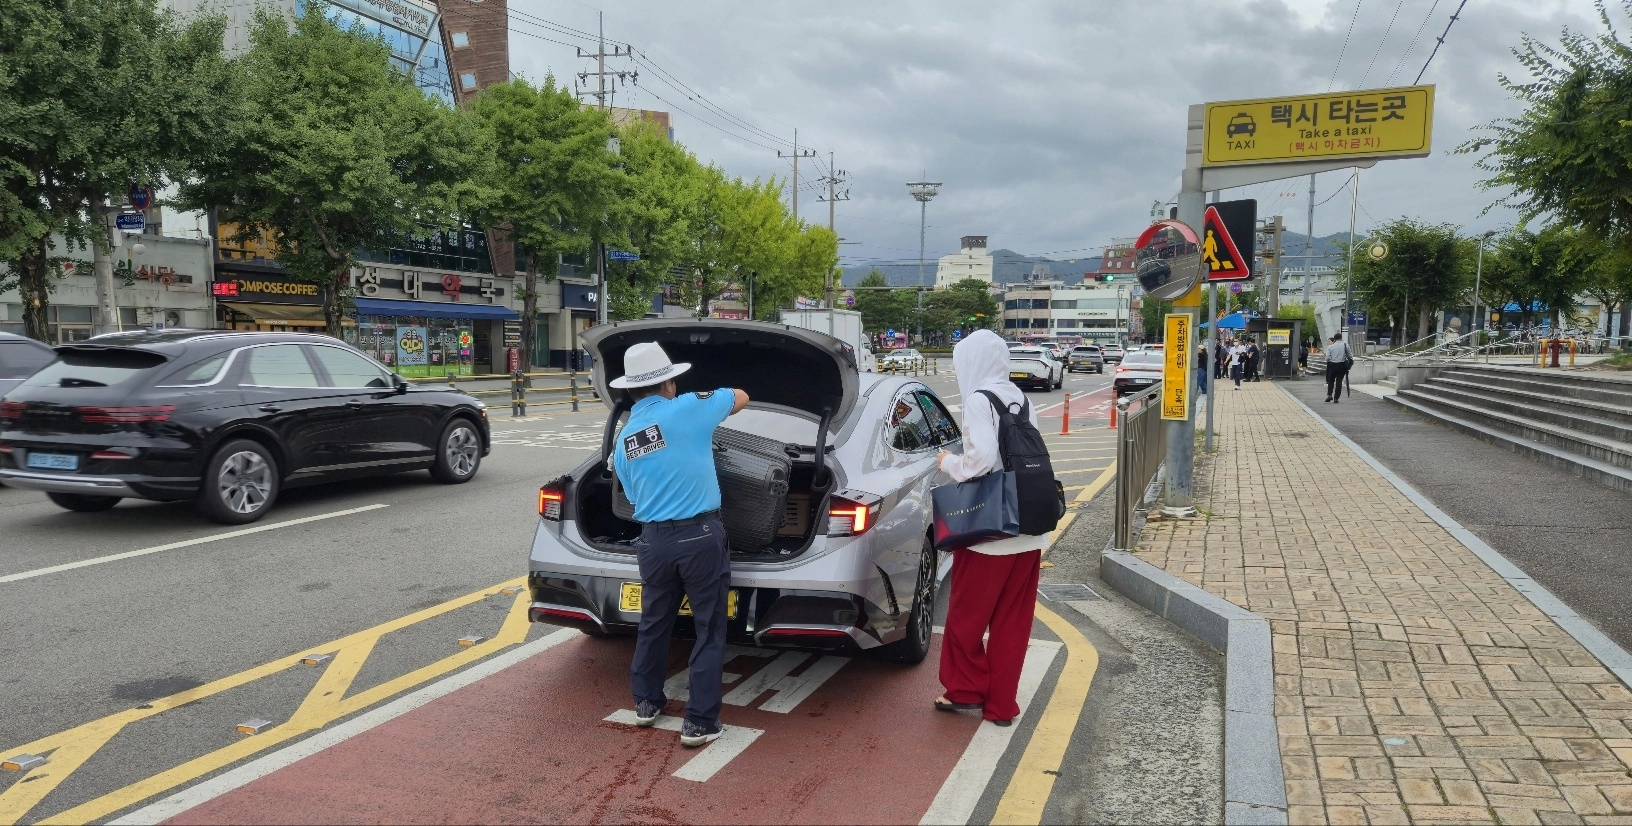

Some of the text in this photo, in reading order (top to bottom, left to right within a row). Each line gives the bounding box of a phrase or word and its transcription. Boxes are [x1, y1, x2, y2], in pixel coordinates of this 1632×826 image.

[1270, 95, 1407, 129] 택시 타는곳
[1299, 125, 1372, 139] Take a taxi
[1227, 140, 1255, 151] TAXI
[1289, 136, 1381, 154] (택시 하차금지)
[283, 283, 318, 296] COFFEE
[400, 338, 424, 354] 임대
[1176, 353, 1184, 369] 위반
[1175, 388, 1183, 404] 단속
[626, 441, 666, 461] BEST DRIVER
